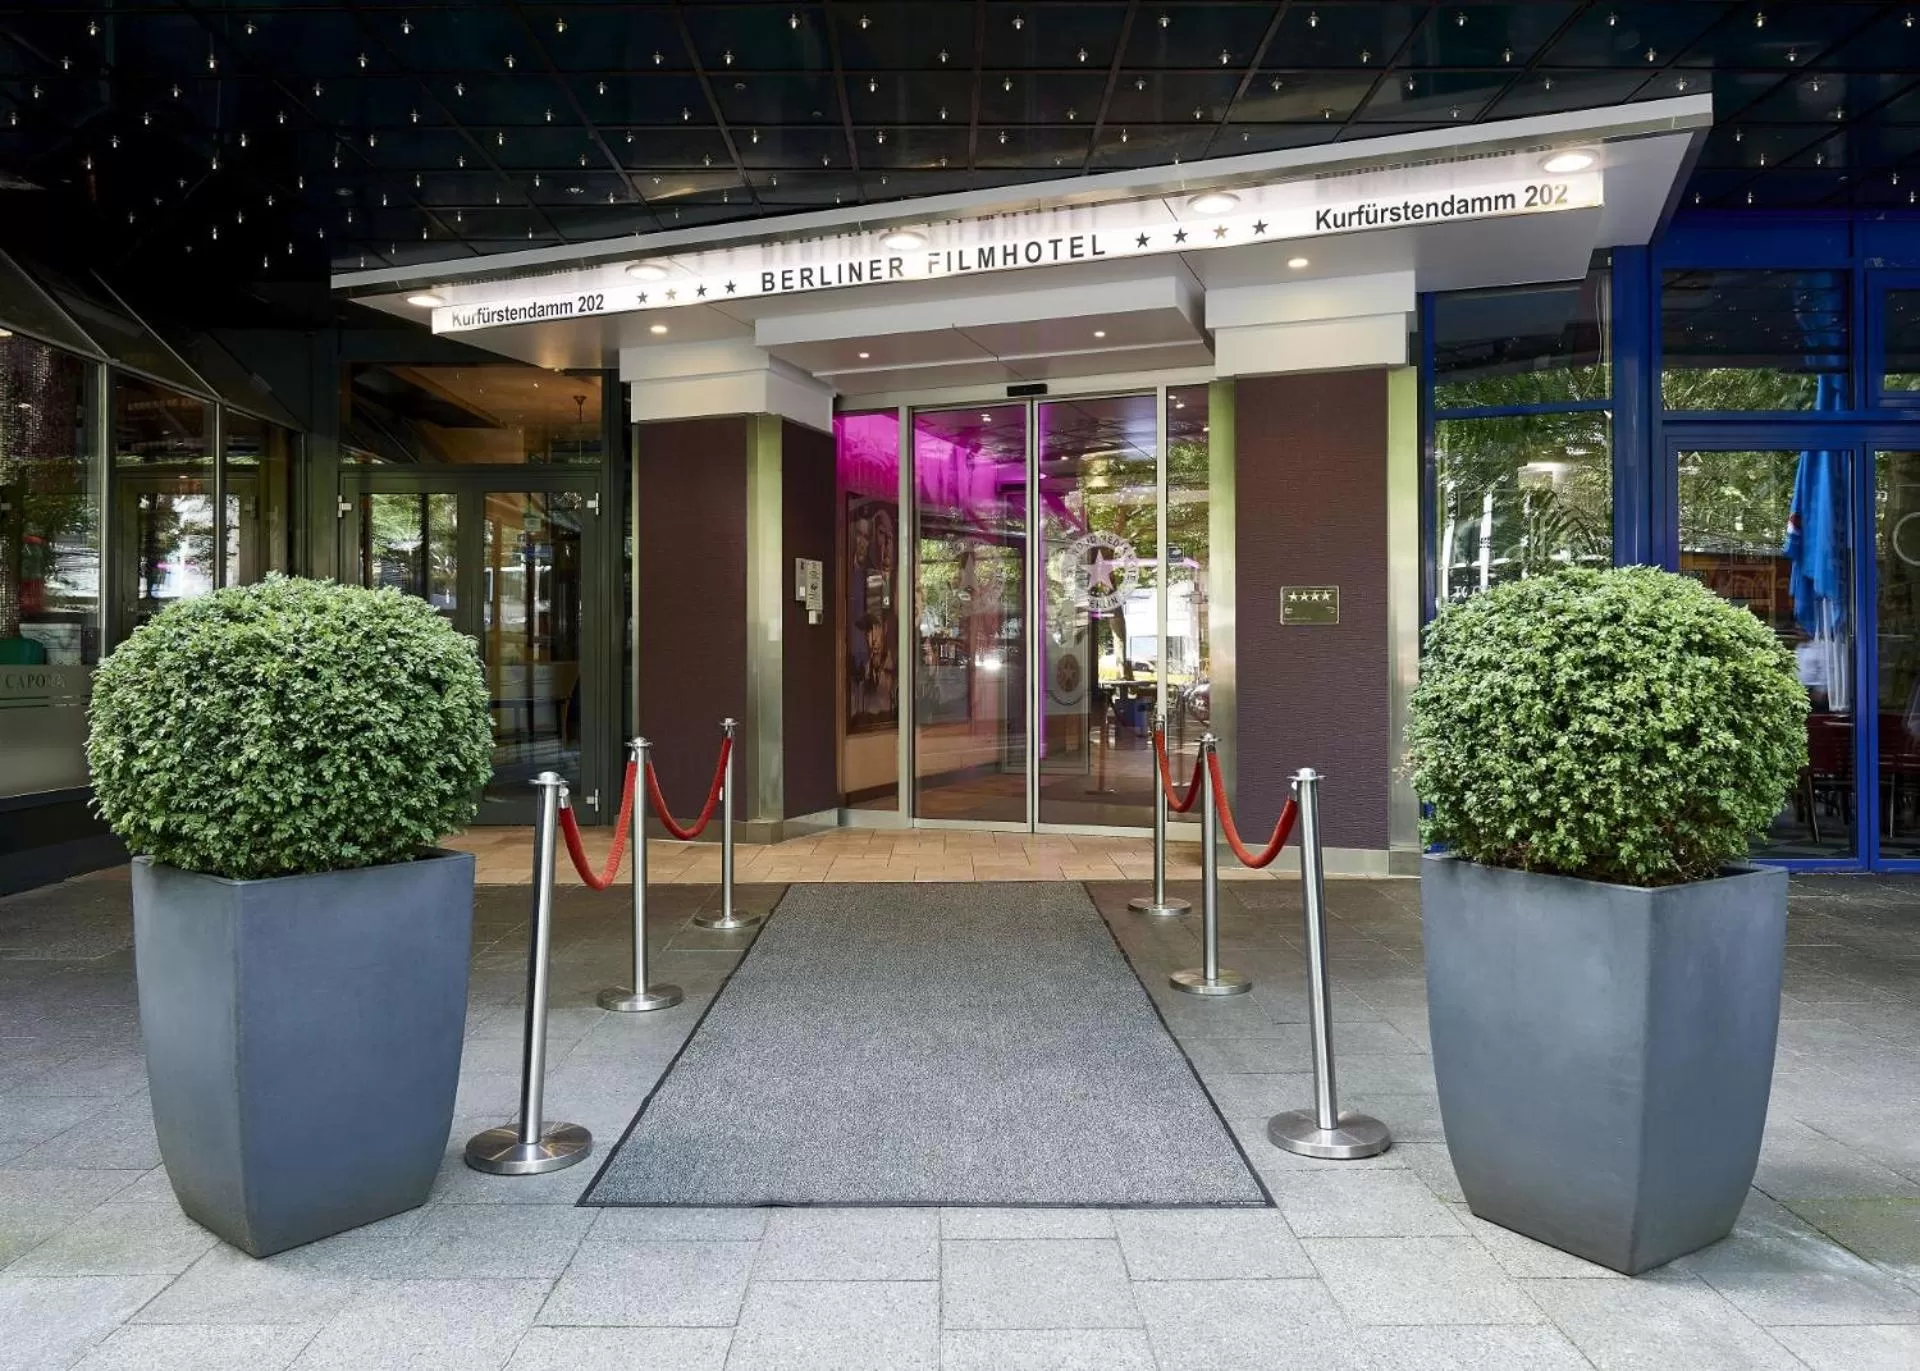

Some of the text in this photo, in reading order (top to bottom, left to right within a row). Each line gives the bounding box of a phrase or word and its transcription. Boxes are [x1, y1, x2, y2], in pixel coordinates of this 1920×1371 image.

[1315, 183, 1568, 230] Kurfürstendamm 202
[761, 234, 1105, 292] BERLINER FILMHOTEL
[452, 294, 604, 328] Kurfürstendamm 202
